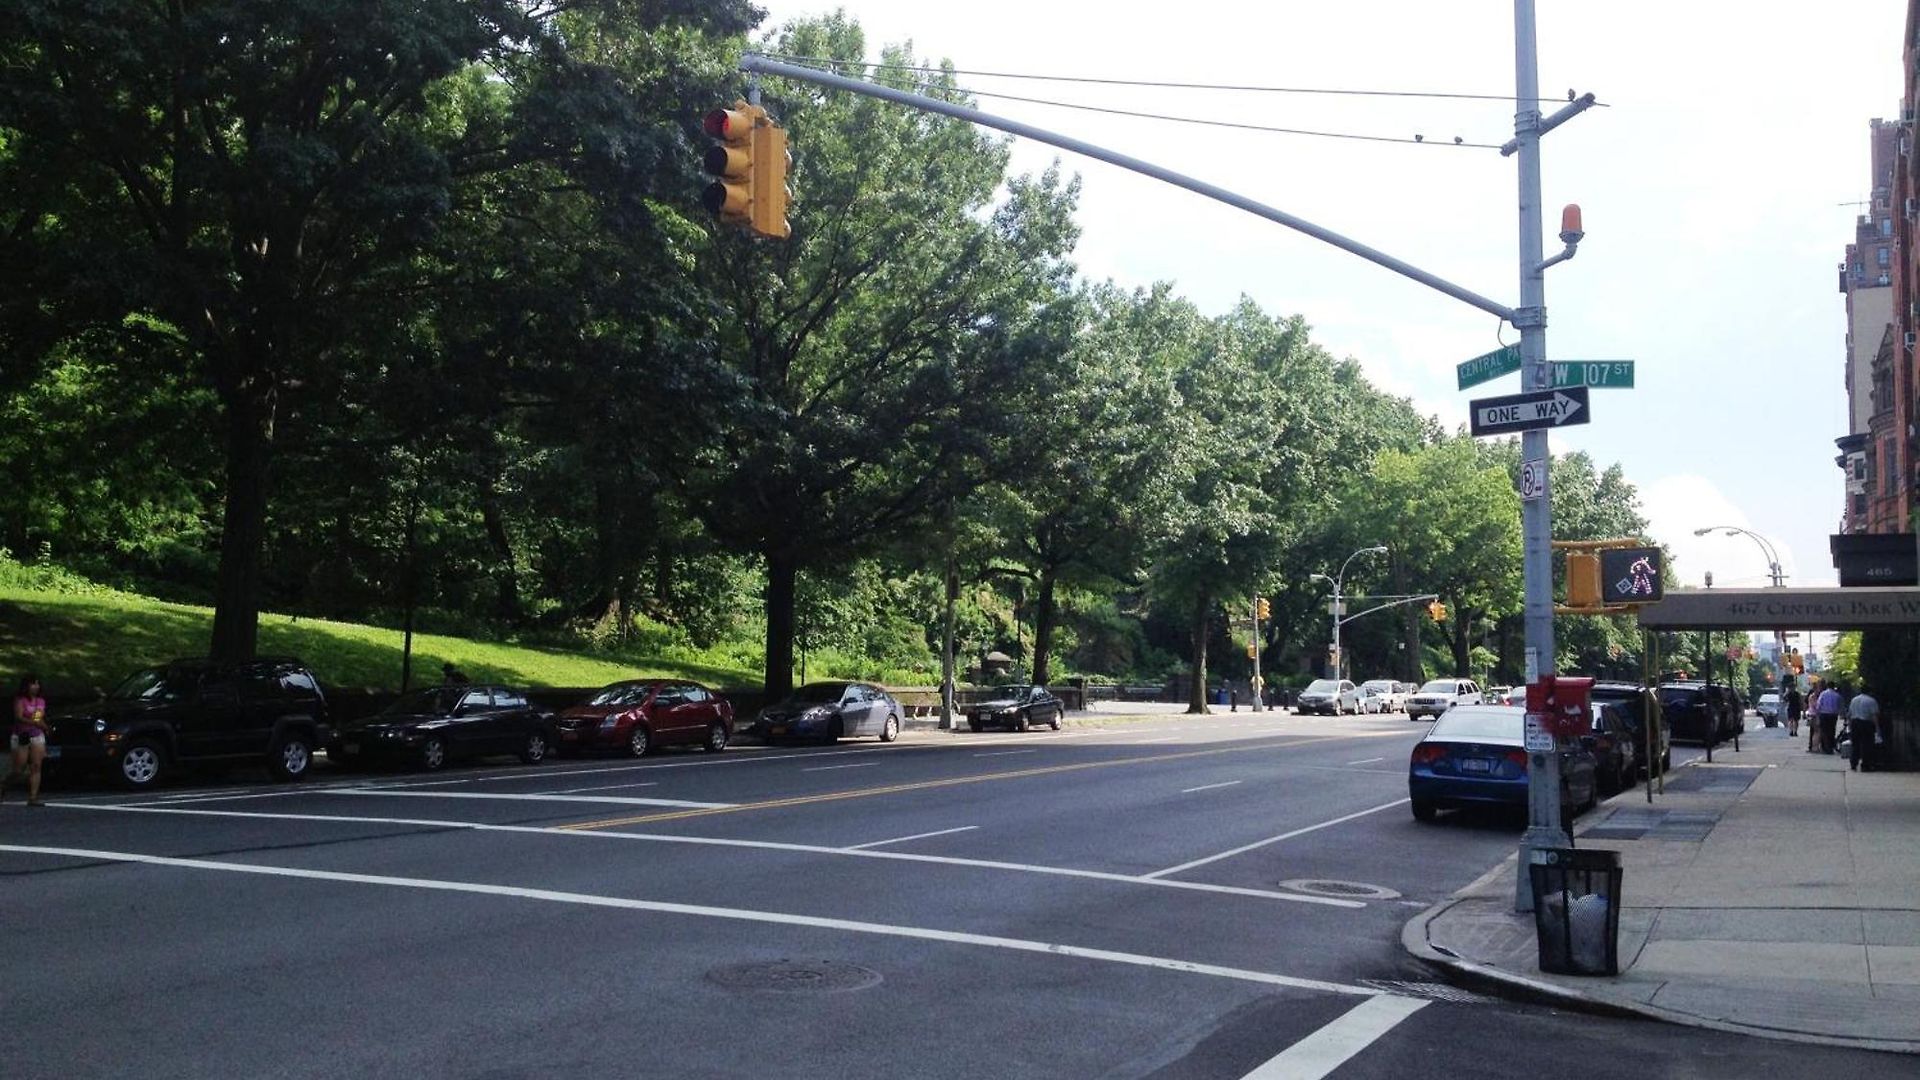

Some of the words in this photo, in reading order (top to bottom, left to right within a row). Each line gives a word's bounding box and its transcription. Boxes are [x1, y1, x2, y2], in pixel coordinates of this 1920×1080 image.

[1460, 350, 1503, 379] CENTRAL
[1507, 347, 1520, 361] PA
[1555, 364, 1569, 385] W
[1582, 363, 1611, 385] 107
[1614, 363, 1630, 375] ST
[1487, 406, 1520, 423] ONE
[1535, 400, 1569, 418] WAY
[1726, 602, 1760, 615] 467
